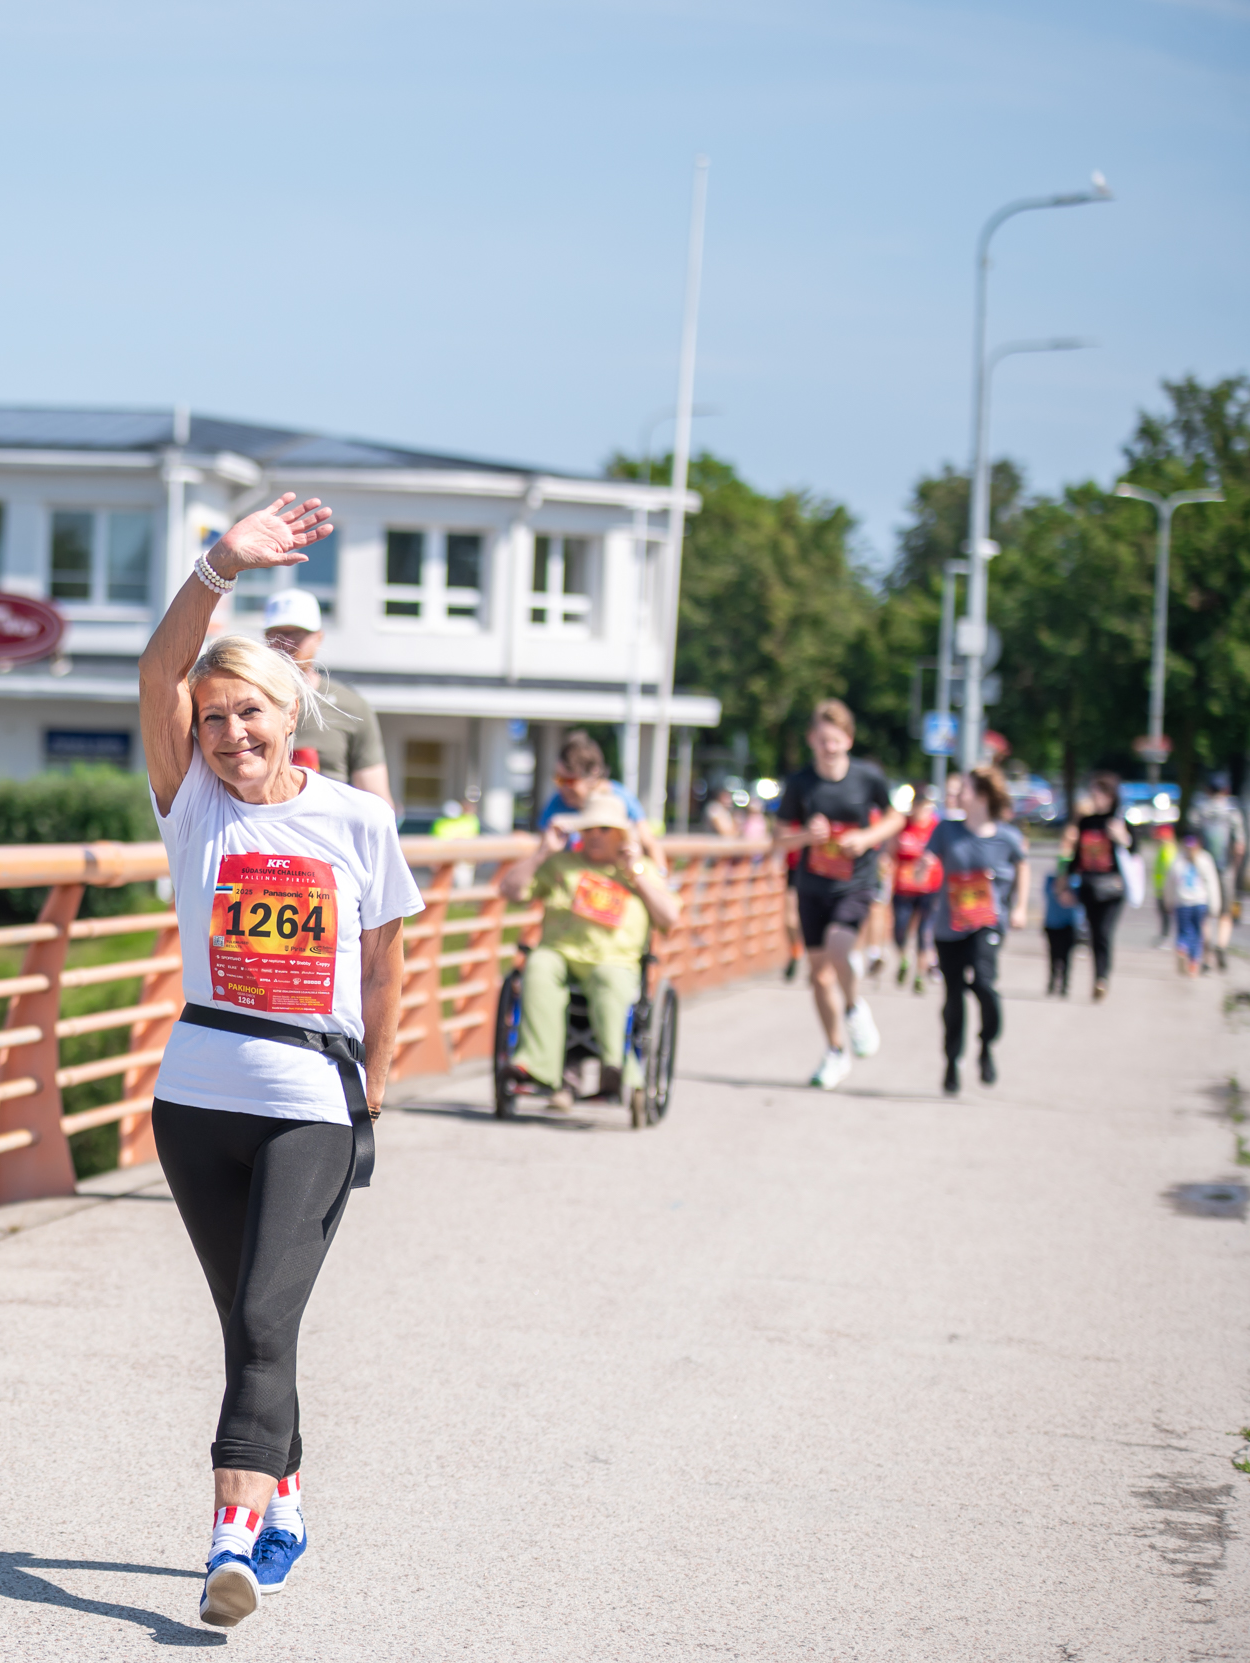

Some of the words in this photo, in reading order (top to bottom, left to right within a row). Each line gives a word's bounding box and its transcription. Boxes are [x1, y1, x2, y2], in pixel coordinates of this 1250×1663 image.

[266, 859, 290, 869] KFC
[241, 867, 275, 875] SÜDASUVE
[277, 869, 315, 877] CHALLENGE
[240, 874, 277, 882] TALLINN
[236, 888, 253, 896] 2025
[263, 889, 303, 899] Panasonic
[308, 891, 314, 899] 4
[316, 891, 330, 901] km
[225, 901, 326, 941] 1264
[228, 982, 265, 996] PAKIHOID
[238, 996, 255, 1005] 1264
